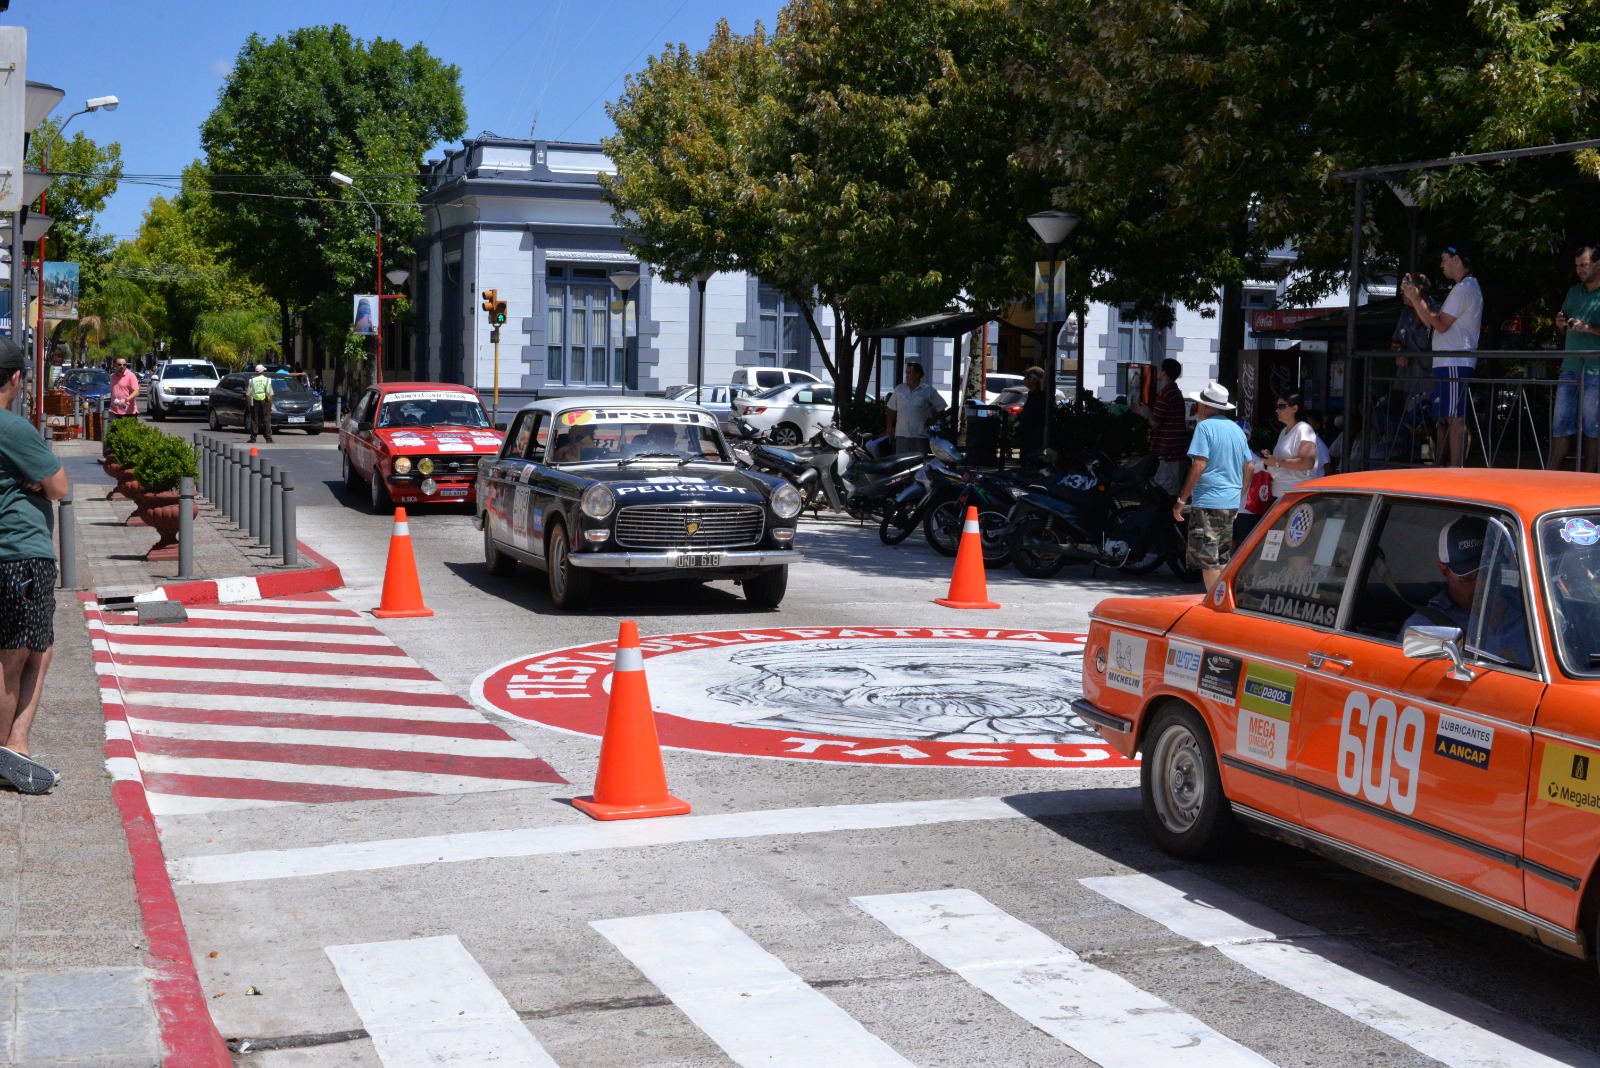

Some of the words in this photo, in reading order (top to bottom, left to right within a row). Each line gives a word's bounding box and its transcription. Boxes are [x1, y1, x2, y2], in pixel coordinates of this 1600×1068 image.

[616, 484, 747, 496] PEUGEOT
[701, 555, 719, 566] 618
[1260, 593, 1336, 626] A.DALMAS
[691, 631, 784, 644] LA
[790, 628, 1052, 641] PATRIA
[1108, 672, 1140, 688] MICHELIN
[1250, 683, 1287, 701] redpagos
[1249, 716, 1276, 740] MEGA
[1440, 719, 1491, 742] LUBRICANTES
[781, 737, 1112, 761] TACU
[1249, 734, 1268, 749] OMEGA
[1268, 741, 1275, 759] 3
[1337, 690, 1425, 816] 609
[1449, 743, 1487, 763] ANCAP
